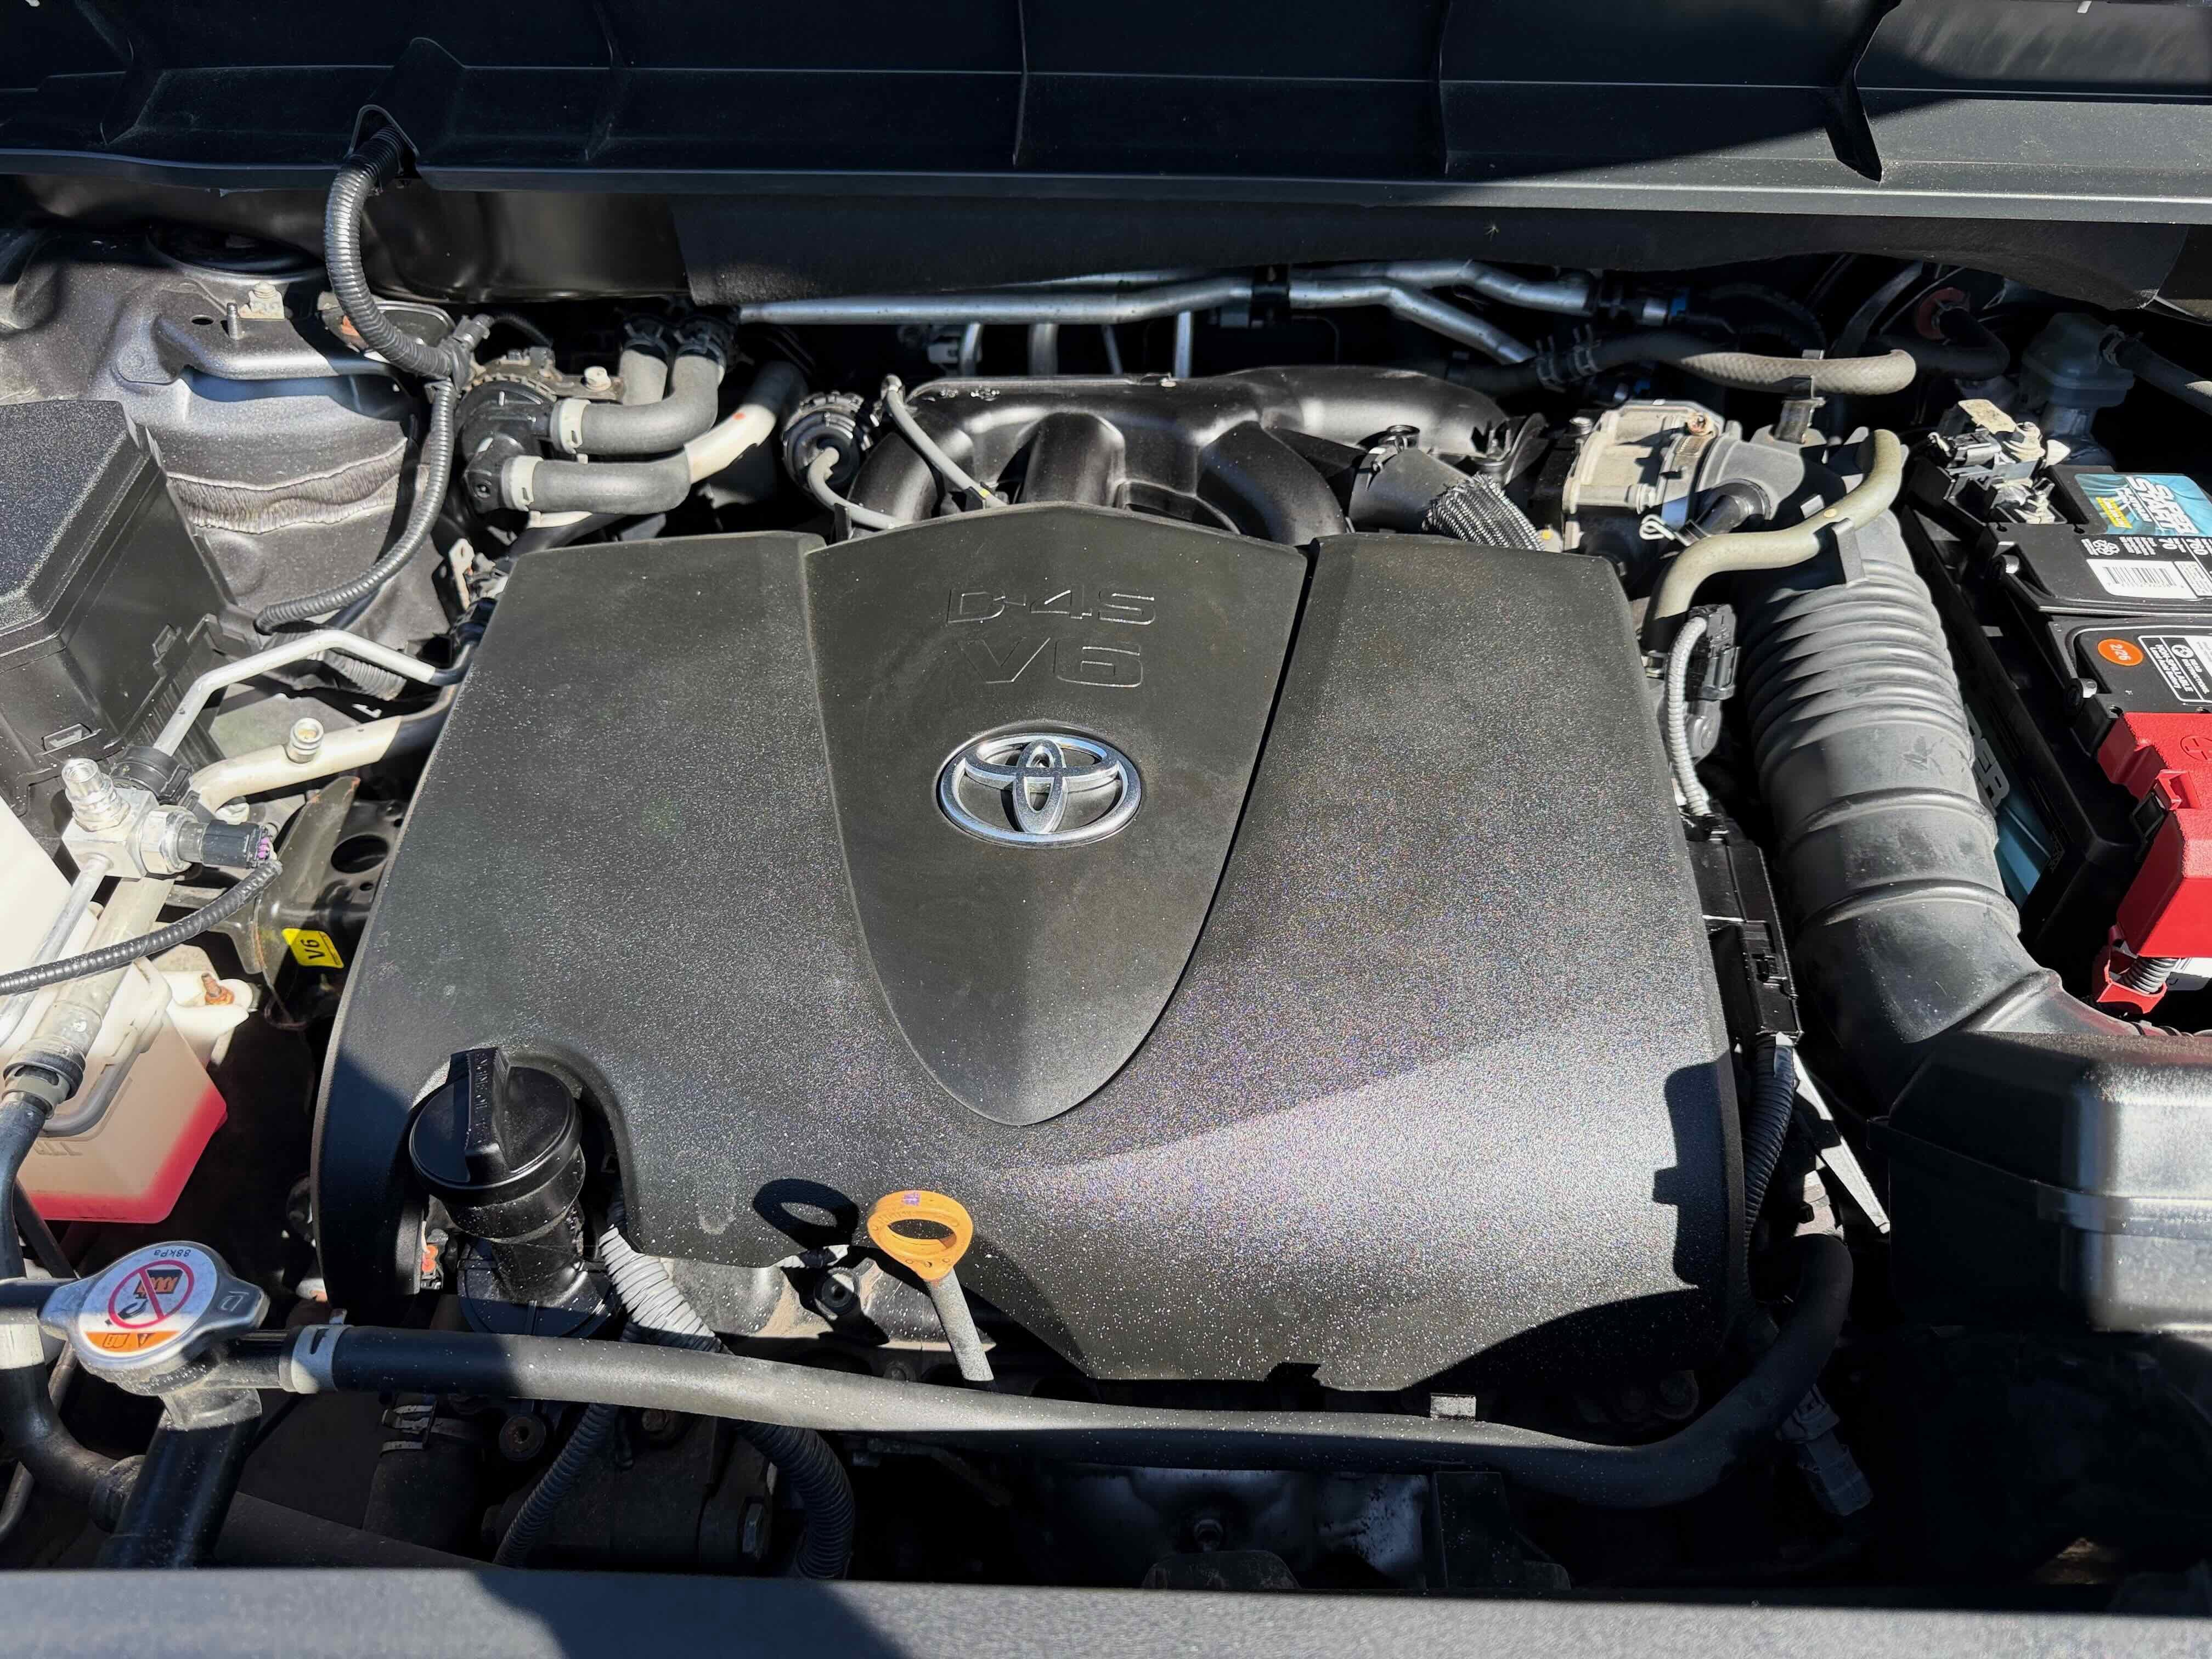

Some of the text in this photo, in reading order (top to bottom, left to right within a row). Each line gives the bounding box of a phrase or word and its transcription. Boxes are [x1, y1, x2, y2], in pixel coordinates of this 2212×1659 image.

[2126, 476, 2176, 531] START
[2151, 484, 2199, 534] SUPER
[2158, 538, 2179, 550] 70
[2186, 538, 2209, 555] 760
[945, 587, 1157, 626] D-4S
[956, 635, 1143, 689] V6
[2109, 644, 2131, 661] 2/26
[2155, 644, 2194, 692] NON-SPILLABLE
[2189, 659, 2203, 673] READ
[1964, 703, 2010, 808] PER
[300, 939, 325, 960] V6
[33, 1141, 83, 1156] ULL
[154, 1249, 191, 1258] 88kPa
